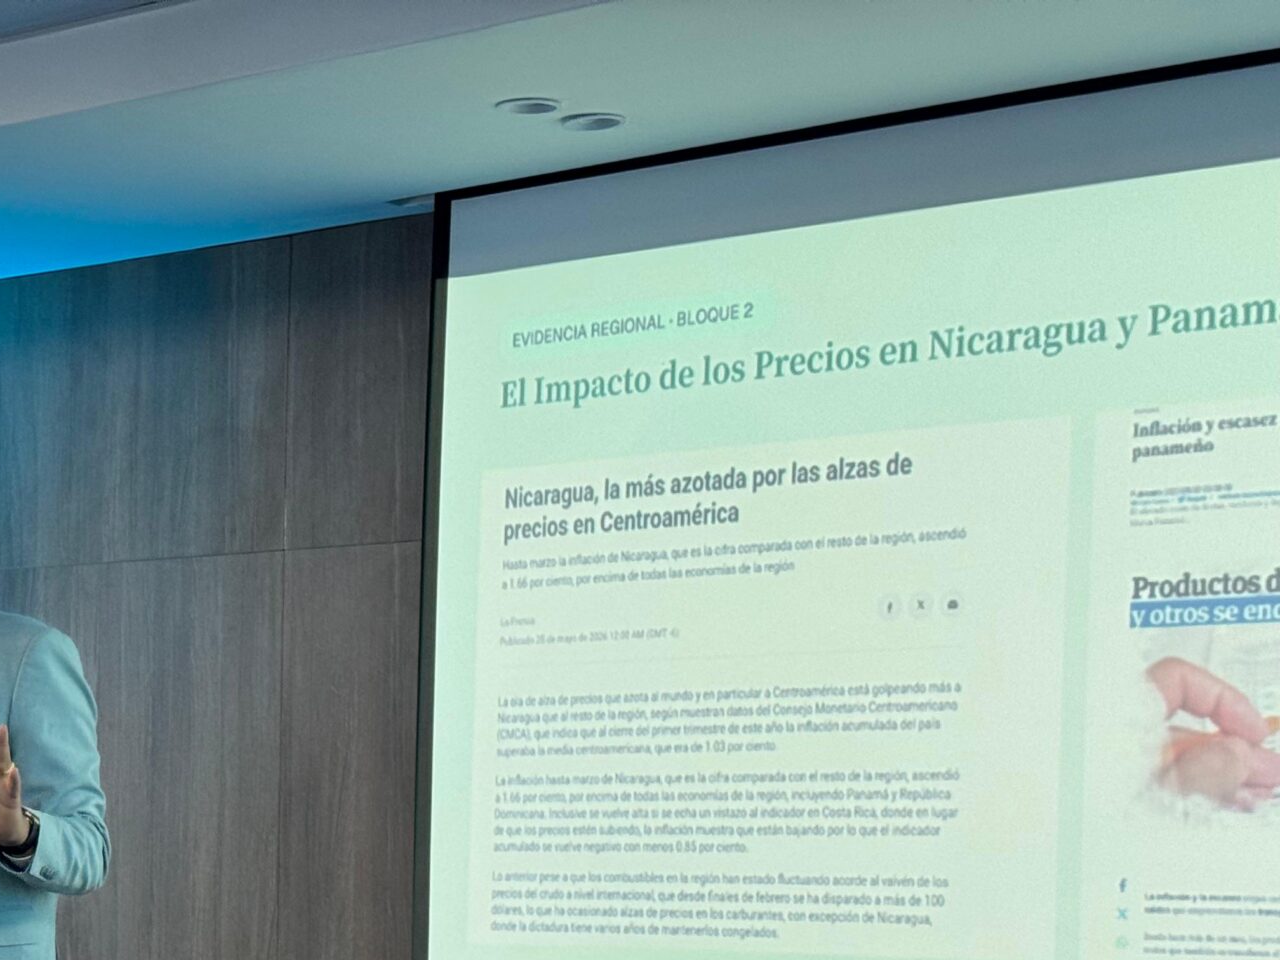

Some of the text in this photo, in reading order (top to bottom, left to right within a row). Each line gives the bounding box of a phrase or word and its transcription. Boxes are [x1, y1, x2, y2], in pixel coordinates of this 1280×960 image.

[512, 325, 587, 348] EVIDENCIA
[590, 315, 665, 337] REGIONAL
[676, 305, 740, 327] BLOQUE
[743, 302, 754, 318] 2
[500, 298, 1280, 408] El Impacto de los Precios en Nicaragua y Panam
[1133, 414, 1277, 437] Inflación y escasez
[1131, 439, 1214, 461] panameño
[505, 451, 913, 510] Nicaragua, la más azotada por las alzas de
[503, 503, 739, 544] precios en Centroamérica
[1132, 572, 1261, 598] Productos
[1132, 608, 1145, 626] y
[1150, 606, 1209, 625] otros
[1213, 605, 1238, 621] se
